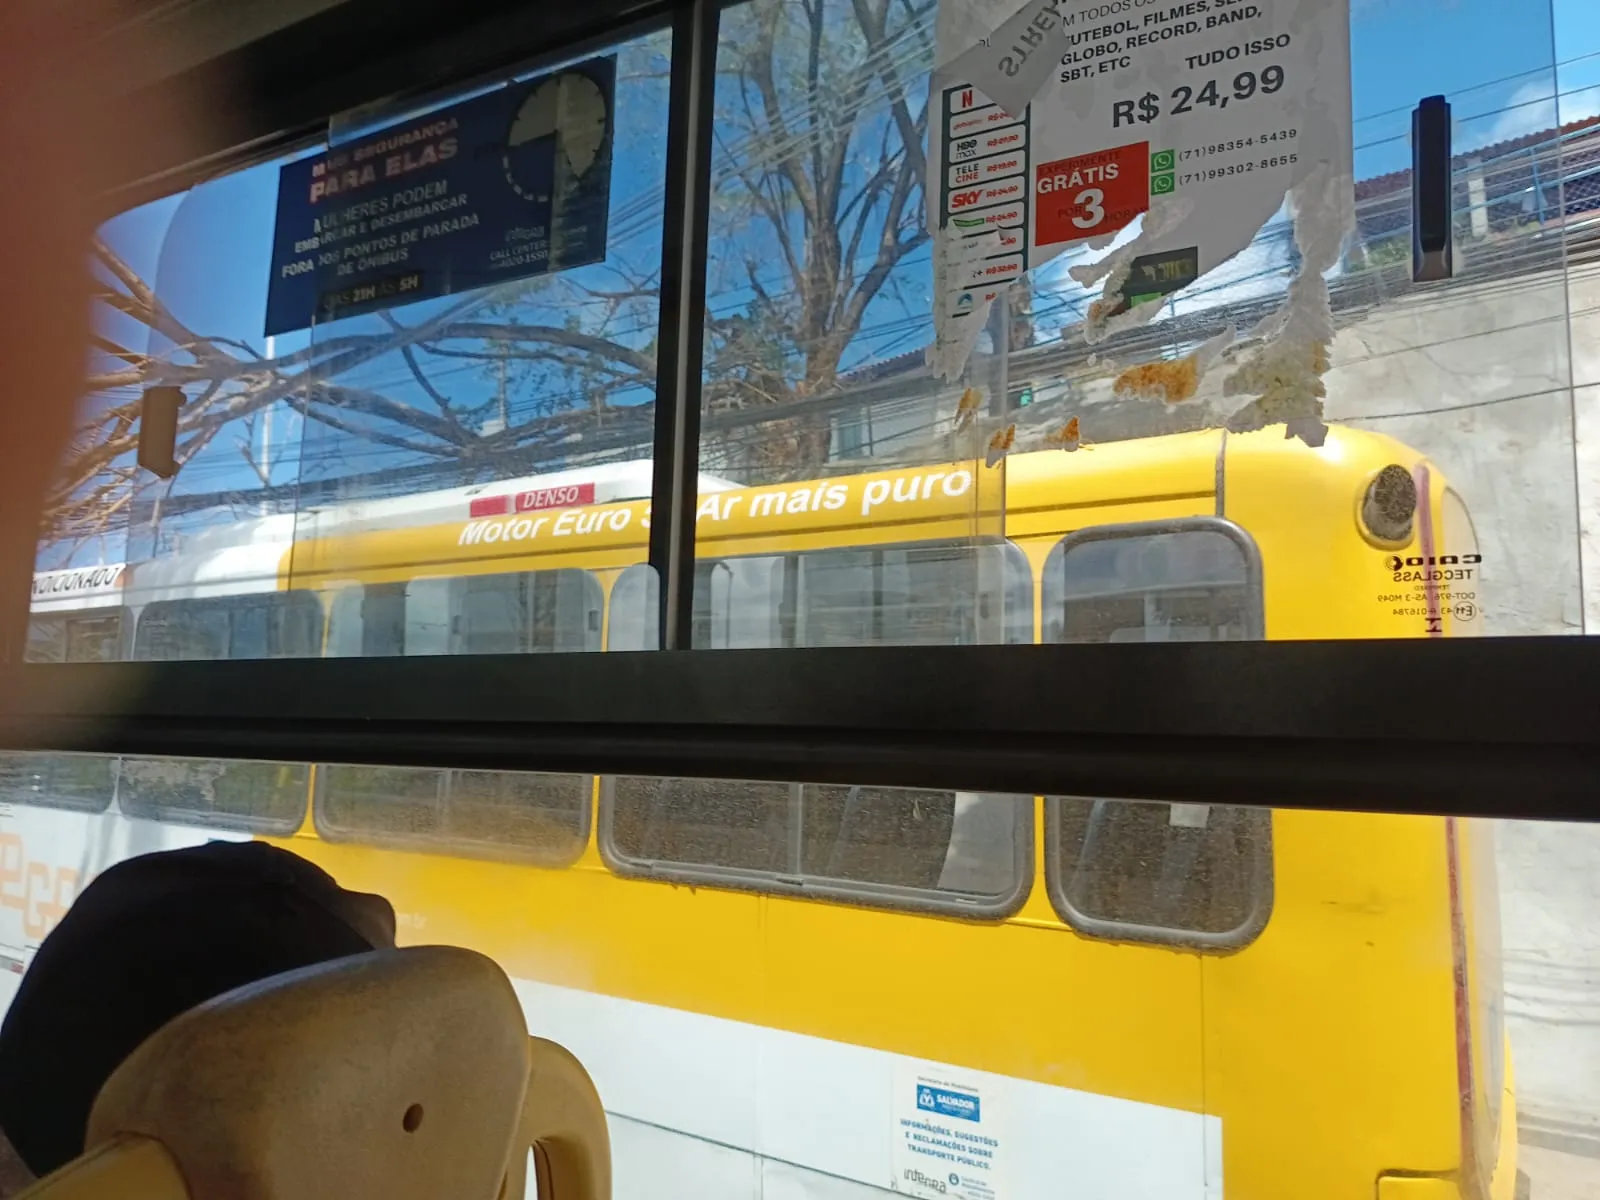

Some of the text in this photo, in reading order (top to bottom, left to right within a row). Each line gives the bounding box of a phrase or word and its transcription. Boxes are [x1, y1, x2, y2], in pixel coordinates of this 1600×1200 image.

[1066, 2, 1211, 46] UTEBOL, FILMES,
[1079, 1, 1131, 22] TODOS
[1061, 6, 1262, 65] GLOBO, RECORD, BAND,
[1185, 34, 1291, 69] TUDO ISSO
[1060, 56, 1131, 83] SBT, ETC
[1113, 65, 1285, 127] R$ 24,99
[1178, 128, 1298, 162] (71)98354-5439
[309, 138, 459, 204] PARA ELAS
[955, 171, 979, 184] CINE
[956, 163, 979, 175] TELE
[1037, 163, 1119, 193] GRÁTIS
[1178, 153, 1298, 186] (71)99302-8655
[391, 180, 448, 209] PODEM
[951, 189, 984, 208] SKY
[1072, 188, 1105, 229] 3
[422, 213, 480, 239] PARADA
[458, 516, 549, 545] Motor
[552, 508, 632, 537] Euro
[696, 494, 743, 521] Ar
[749, 482, 849, 518] mais
[861, 470, 973, 516] puro
[523, 487, 580, 509] DENSO
